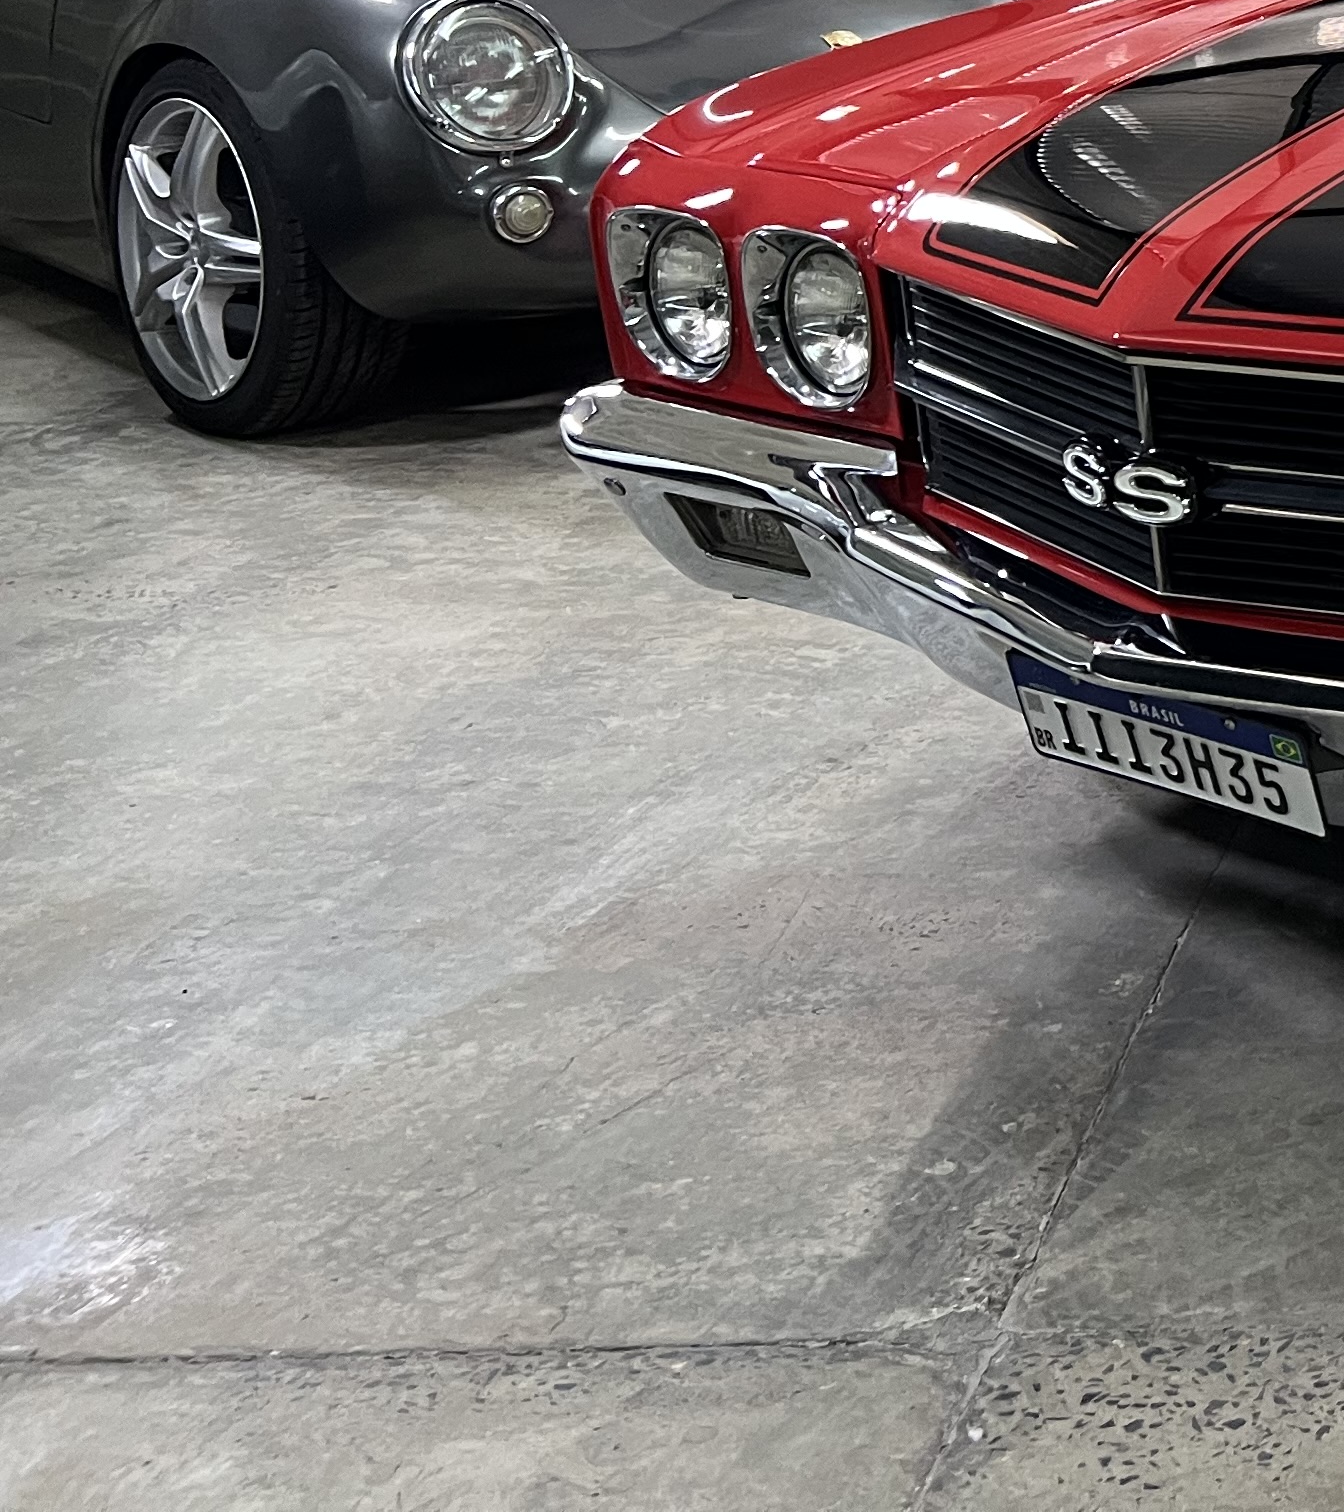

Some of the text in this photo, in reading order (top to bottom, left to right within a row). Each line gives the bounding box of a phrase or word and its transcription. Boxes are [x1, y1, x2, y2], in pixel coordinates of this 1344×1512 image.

[1061, 443, 1190, 525] SS
[1128, 699, 1184, 728] BRASIL
[1034, 726, 1057, 750] BR
